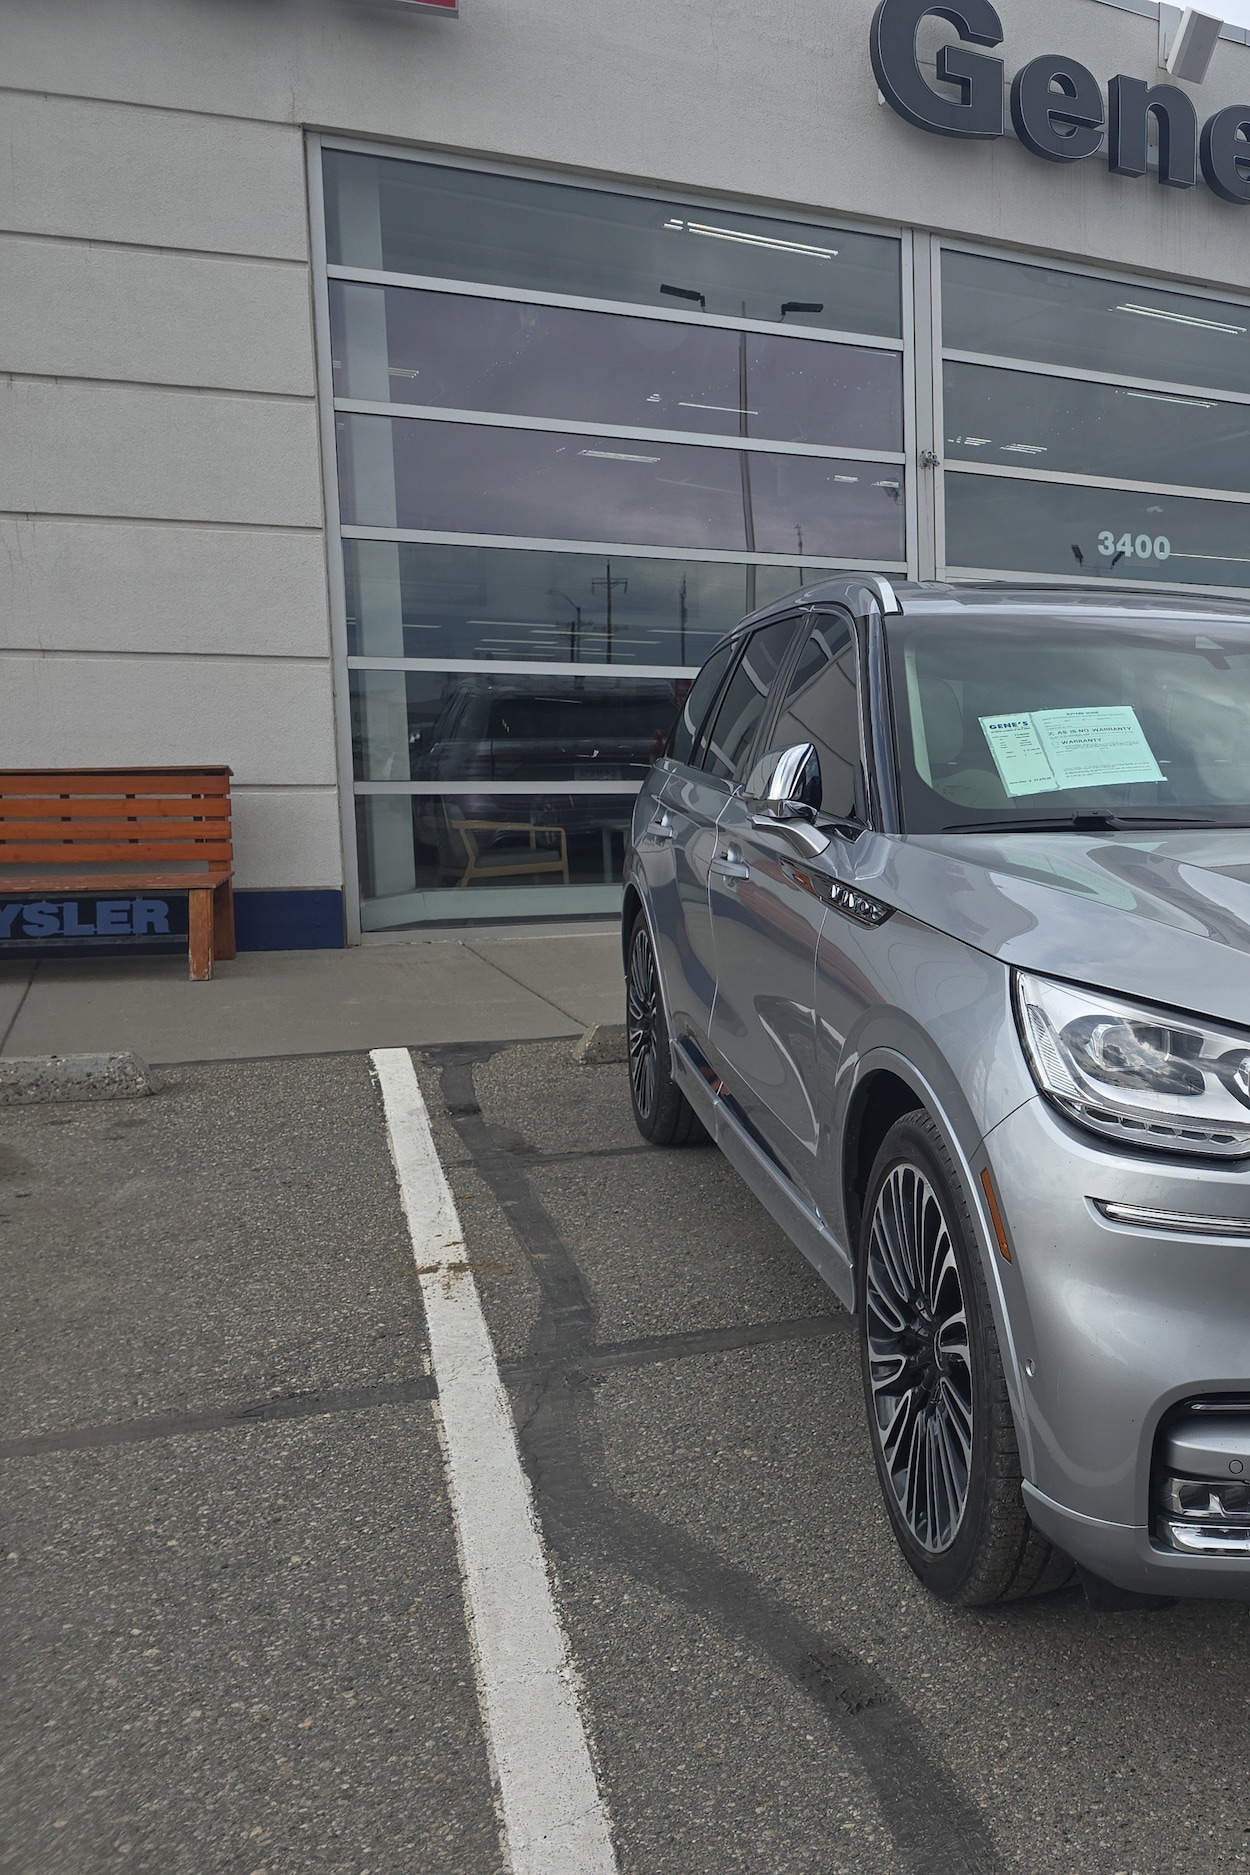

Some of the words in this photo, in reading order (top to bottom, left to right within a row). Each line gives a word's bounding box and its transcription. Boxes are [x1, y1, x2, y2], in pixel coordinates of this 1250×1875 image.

[1097, 530, 1171, 560] 3400
[989, 721, 1029, 730] GENE'S
[1061, 737, 1102, 745] WARRANTY
